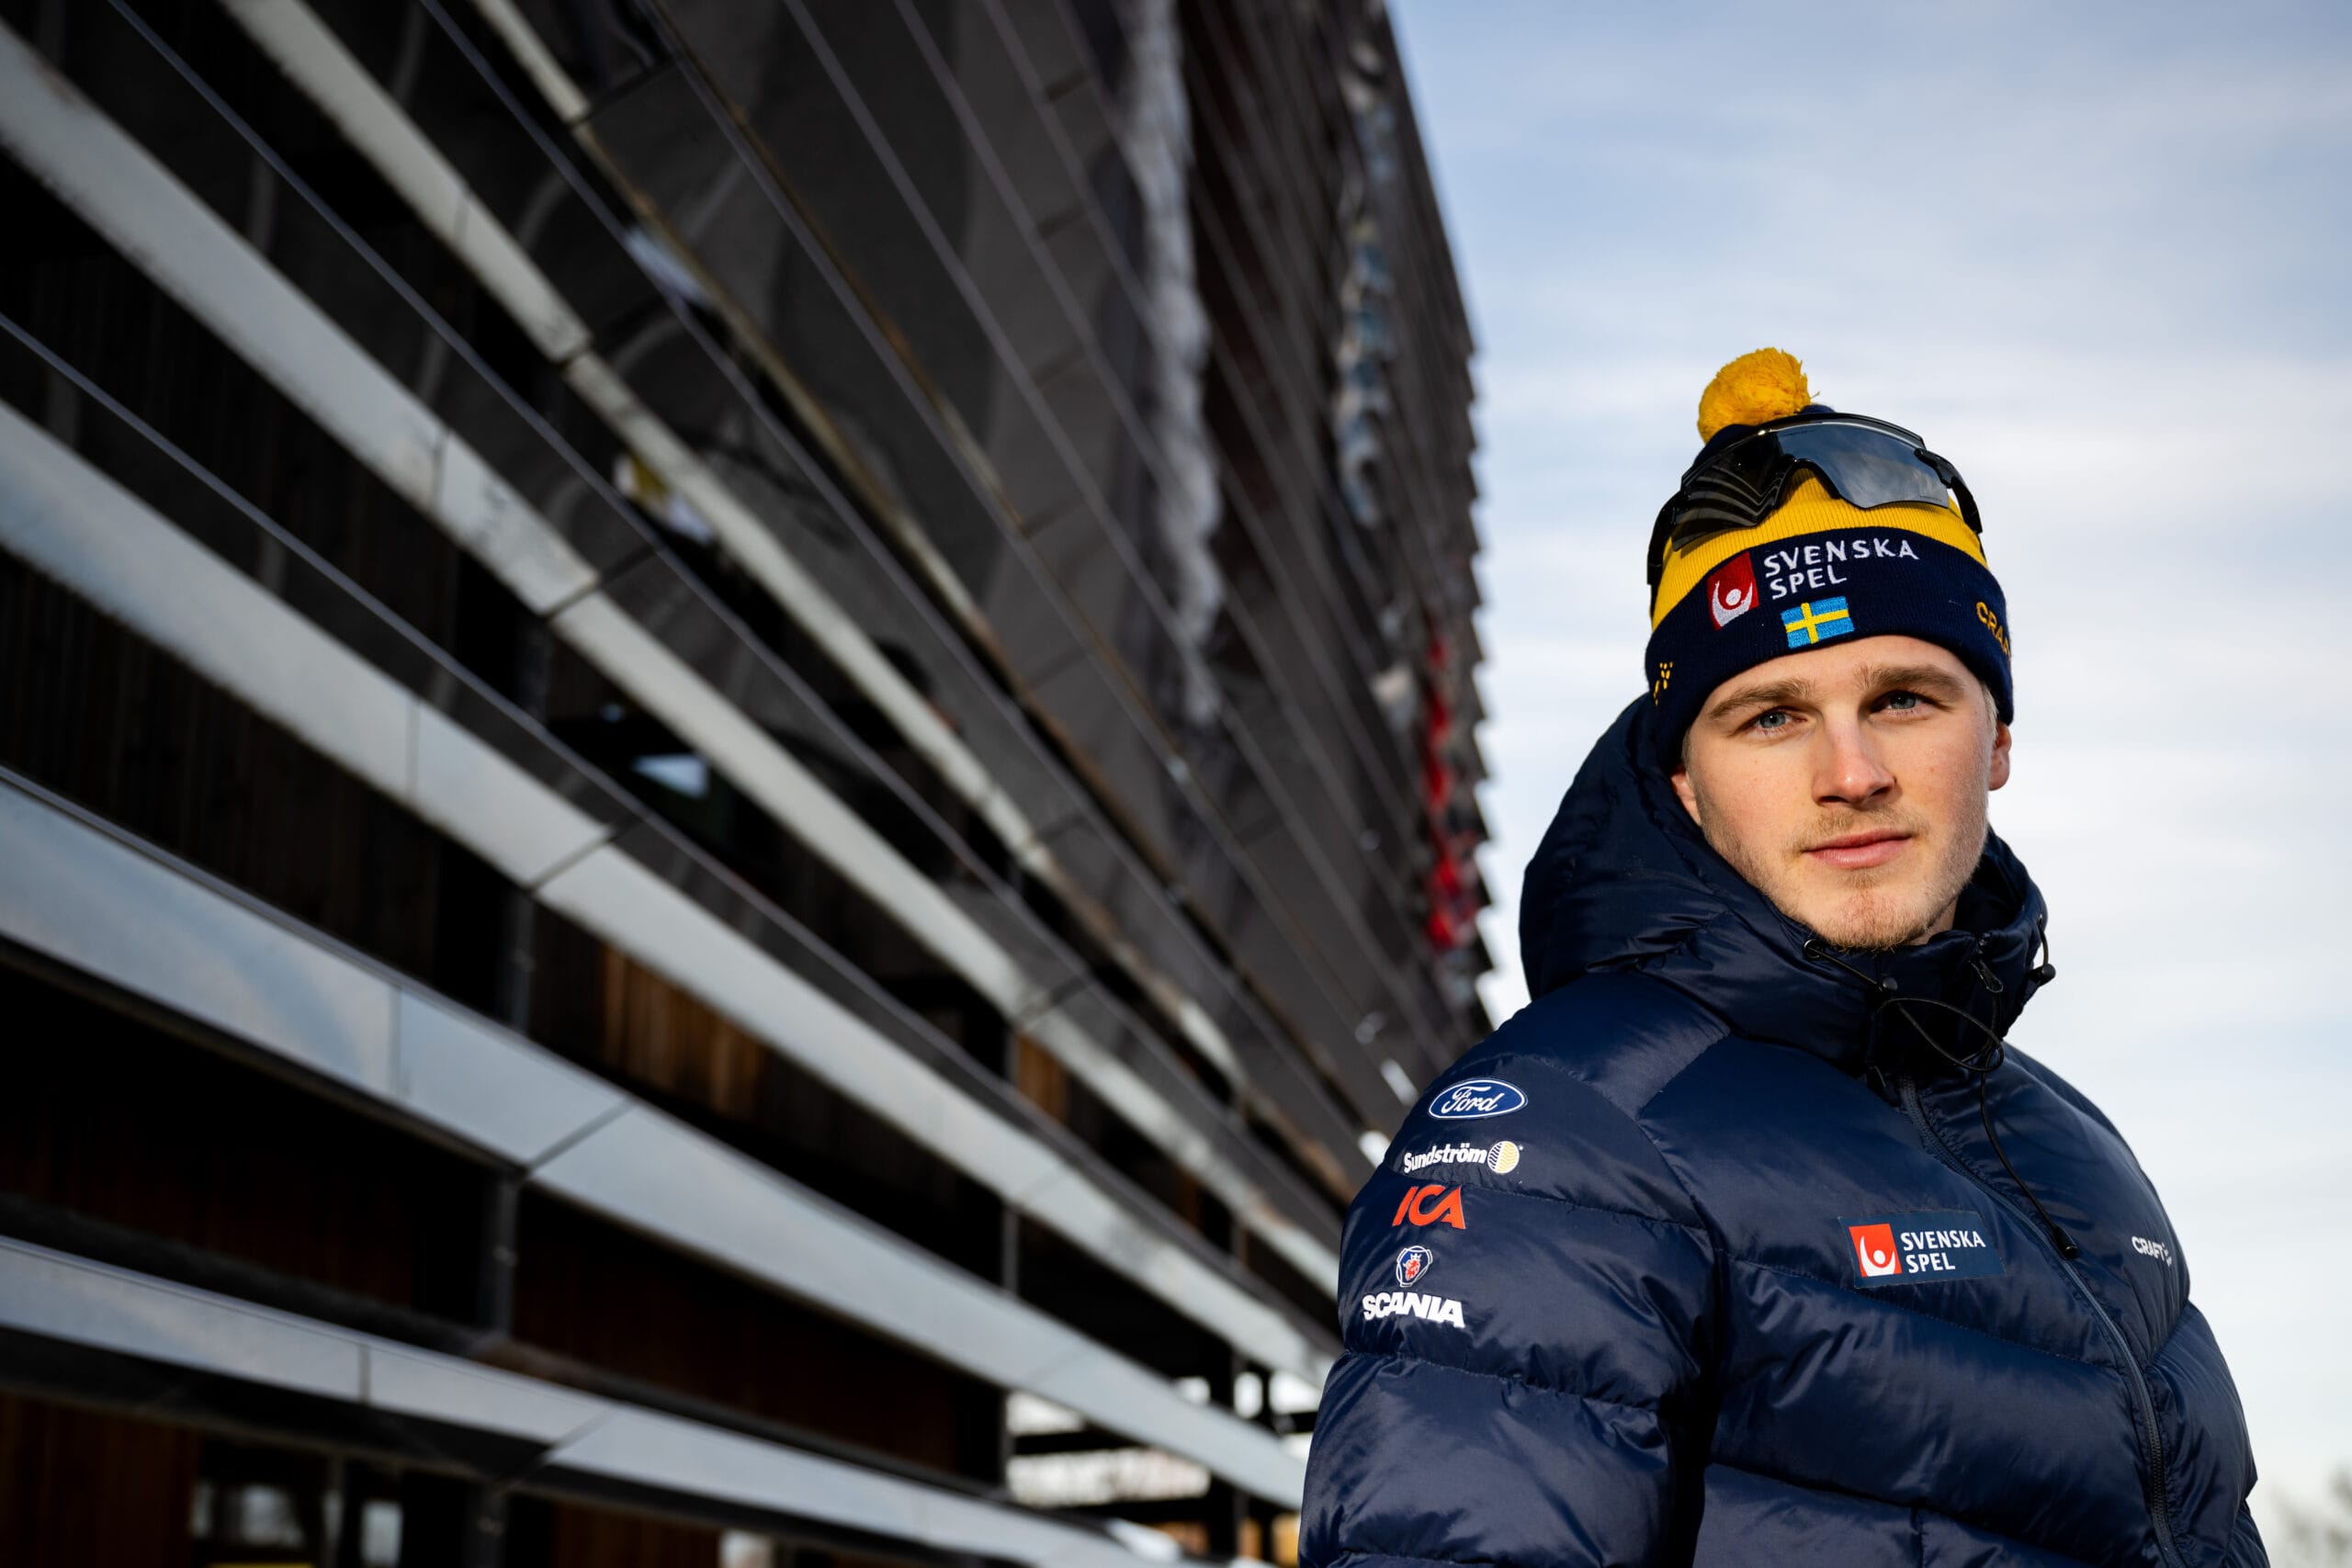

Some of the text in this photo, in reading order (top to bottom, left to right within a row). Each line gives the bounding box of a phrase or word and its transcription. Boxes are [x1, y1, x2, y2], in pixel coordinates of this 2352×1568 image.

[1764, 538, 1919, 578] SVENSKA
[1770, 565, 1847, 599] SPEL
[1442, 1086, 1505, 1114] Ford
[1405, 1143, 1487, 1173] Sundström
[1392, 1185, 1466, 1229] ICA
[1900, 1230, 1985, 1251] SVENSKA
[1906, 1255, 1955, 1274] SPEL
[1363, 1292, 1465, 1328] SCANIA
